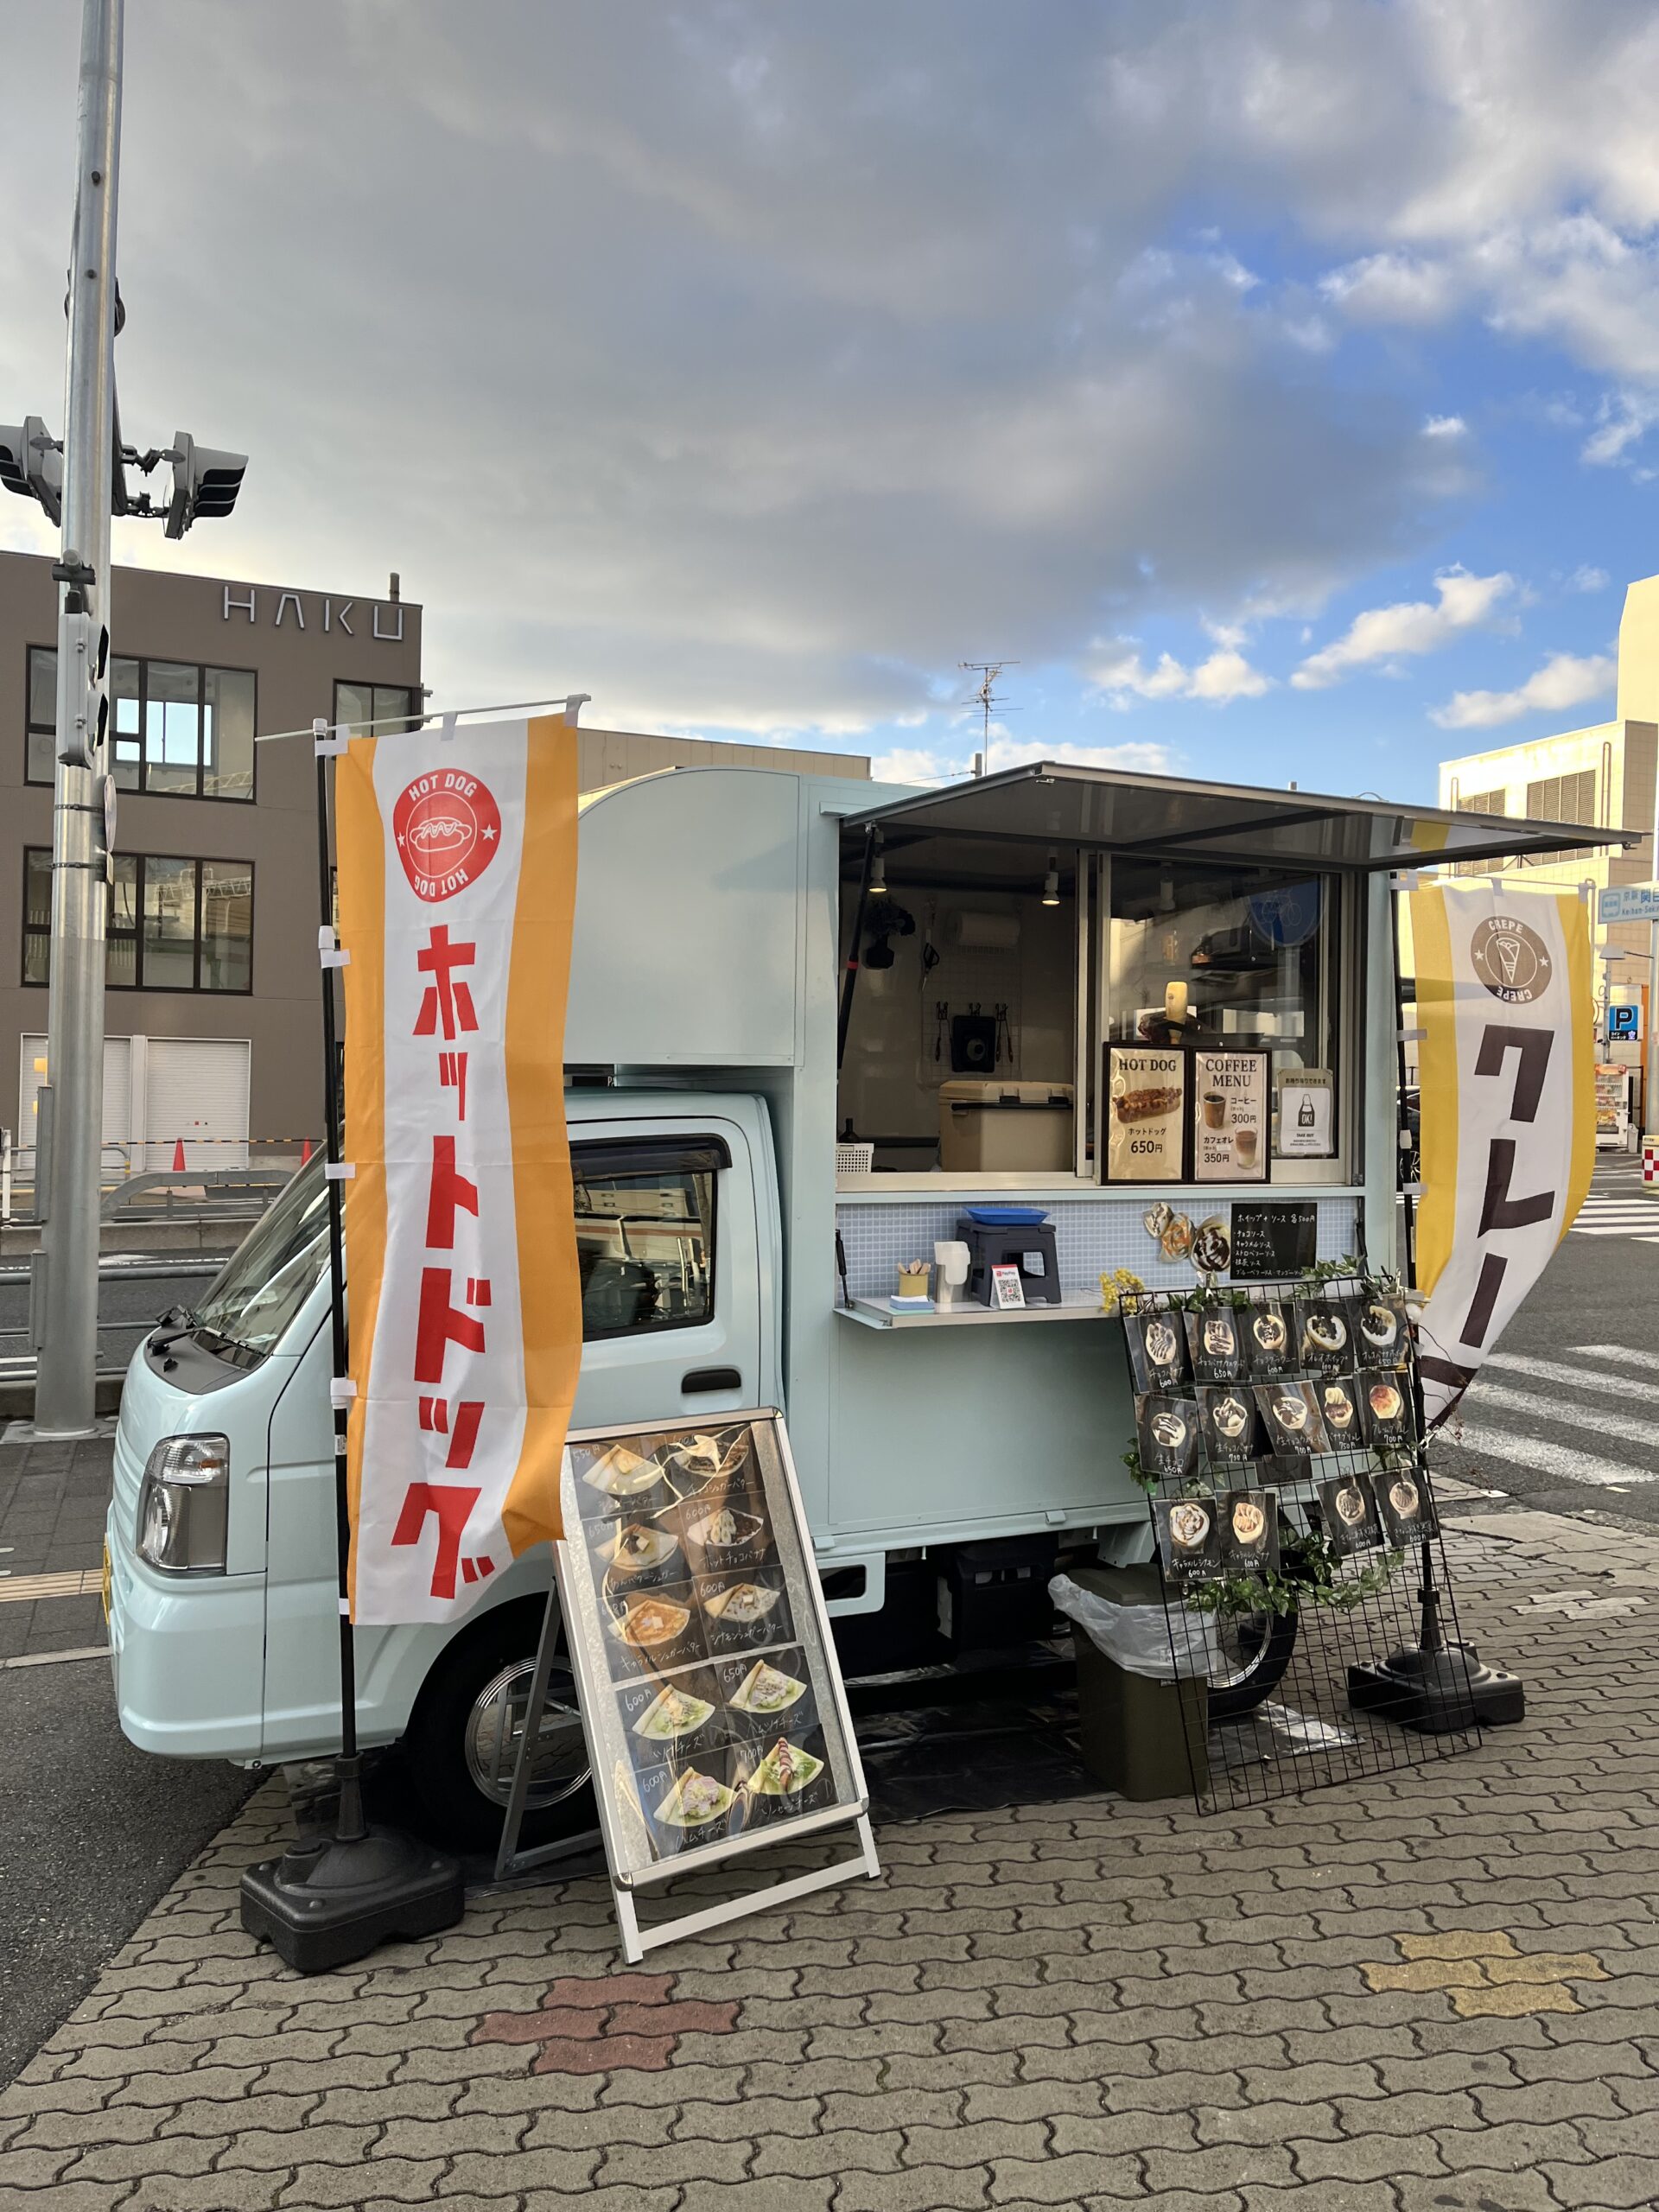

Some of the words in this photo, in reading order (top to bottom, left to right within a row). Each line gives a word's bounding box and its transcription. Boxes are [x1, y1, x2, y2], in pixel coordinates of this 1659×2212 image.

[224, 585, 403, 641] HAKU
[409, 774, 439, 802] HOT
[444, 773, 478, 798] DOG
[414, 874, 435, 897] DOG
[441, 868, 469, 895] HOT
[1488, 918, 1523, 934] CREPE
[1497, 986, 1533, 1001] CREPE
[1615, 1007, 1633, 1030] P
[1119, 1058, 1147, 1071] HOT
[1150, 1059, 1177, 1071] DOG
[1205, 1059, 1257, 1072] COFFEE
[1212, 1074, 1252, 1087] MENU
[1231, 1113, 1257, 1124] 300円
[1301, 1113, 1313, 1124] OK!
[1128, 1127, 1167, 1136] ホットドッグ
[1130, 1140, 1163, 1154] 650円
[1204, 1153, 1230, 1163] 350円
[391, 924, 496, 1600] ホットドッグ
[700, 1581, 726, 1598] 600円
[723, 1662, 747, 1683] 650円
[625, 1688, 652, 1712] 600円
[642, 1770, 668, 1793] 600円
